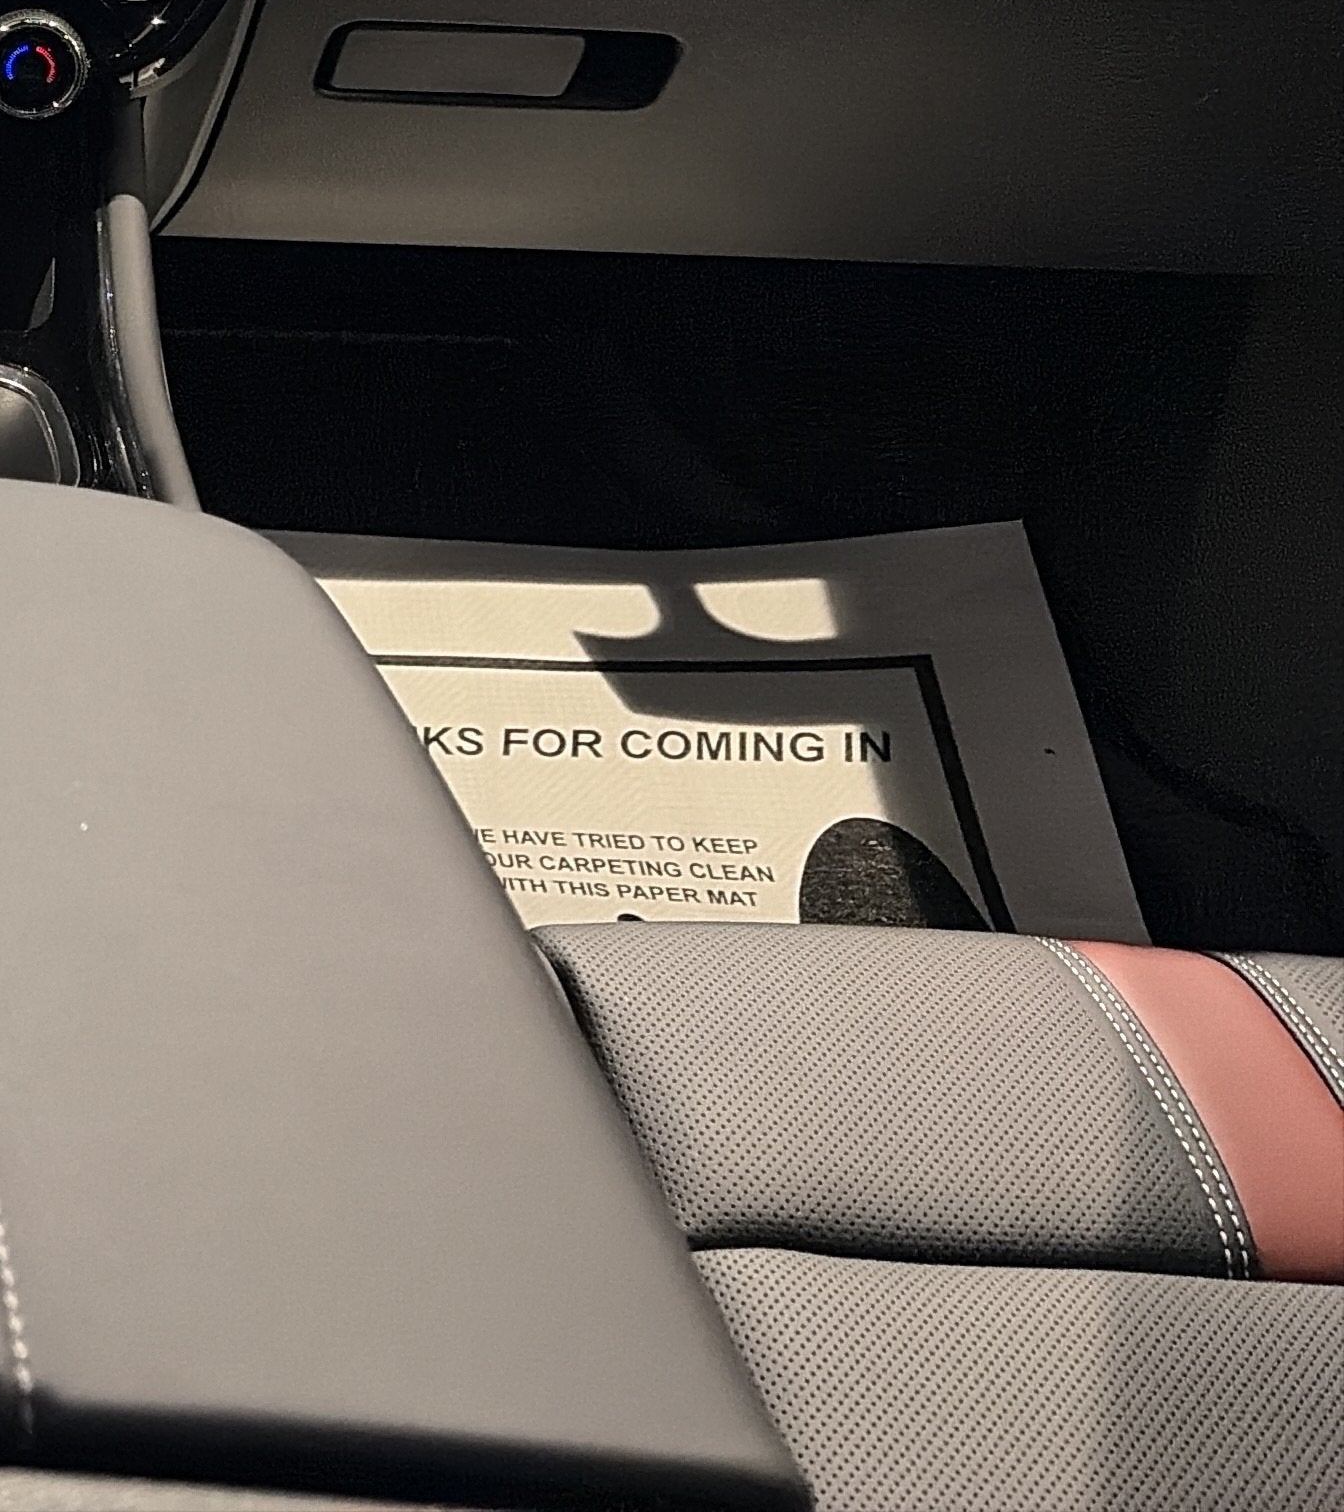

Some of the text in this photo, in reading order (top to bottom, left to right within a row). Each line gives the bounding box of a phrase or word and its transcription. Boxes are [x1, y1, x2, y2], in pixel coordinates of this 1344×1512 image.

[502, 728, 603, 758] FOR
[621, 729, 824, 762] COMING
[844, 731, 891, 763] IN
[475, 829, 758, 854] E HAVE TRIED TO KEEP
[539, 855, 682, 877] CARPETING
[689, 862, 776, 883] CLEAN
[552, 879, 610, 898] THIS
[616, 884, 701, 904] PAPER
[707, 890, 758, 907] MAT
